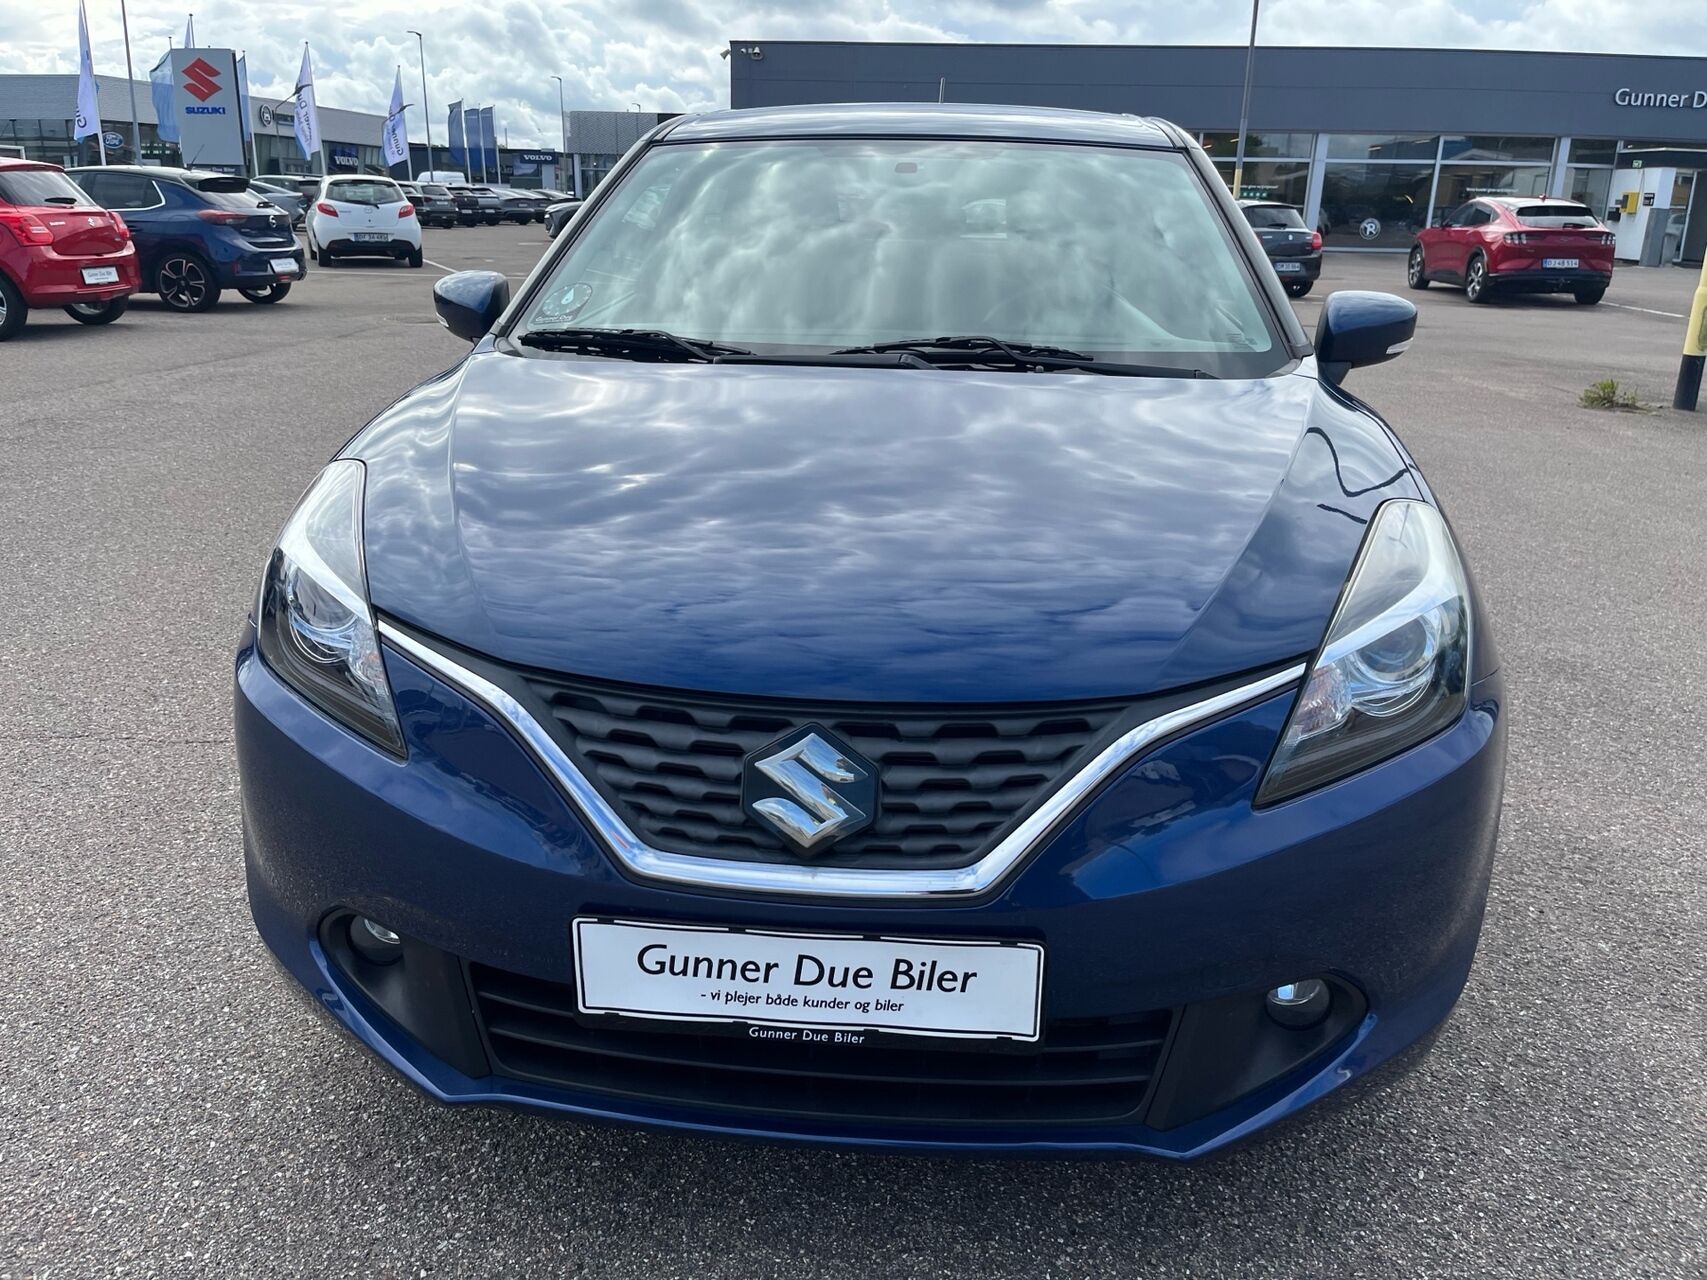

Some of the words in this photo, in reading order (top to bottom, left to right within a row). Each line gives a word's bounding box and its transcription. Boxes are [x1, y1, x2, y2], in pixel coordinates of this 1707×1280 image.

[1615, 87, 1689, 108] Gunner
[185, 106, 226, 115] SUZUKI
[334, 155, 359, 166] VOLVO
[523, 154, 553, 162] VOLVO
[637, 944, 779, 984] Gunner
[793, 953, 874, 990] Due
[889, 958, 978, 993] Biler
[710, 990, 721, 1001] vi
[724, 990, 762, 1007] plejer
[765, 993, 799, 1007] både
[802, 995, 851, 1010] kunder
[854, 1000, 871, 1014] og
[874, 998, 905, 1012] biler
[748, 1025, 798, 1040] Gunner
[802, 1029, 829, 1042] Due
[834, 1031, 866, 1044] Biler
